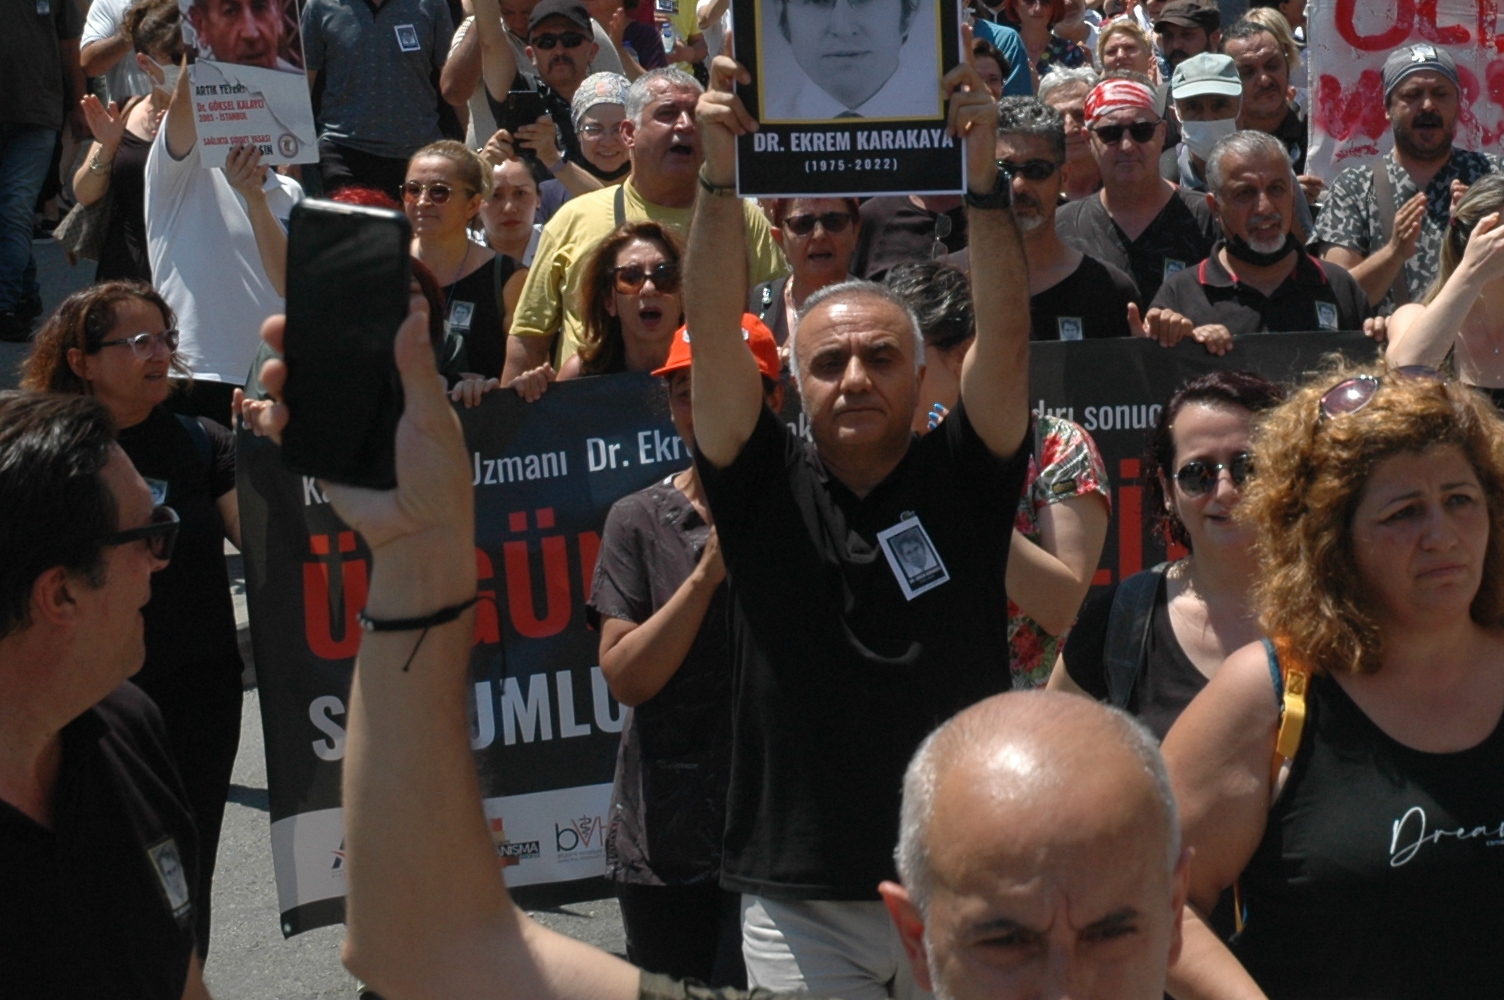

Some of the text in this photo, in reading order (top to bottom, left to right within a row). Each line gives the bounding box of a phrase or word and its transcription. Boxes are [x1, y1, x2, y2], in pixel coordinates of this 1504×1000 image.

[196, 85, 218, 96] ARTIK
[753, 128, 954, 152] DR. EKREM KARAKAYA
[805, 158, 898, 173] (1975-2022)
[587, 437, 630, 473] Dr.
[639, 429, 693, 466] Ekr
